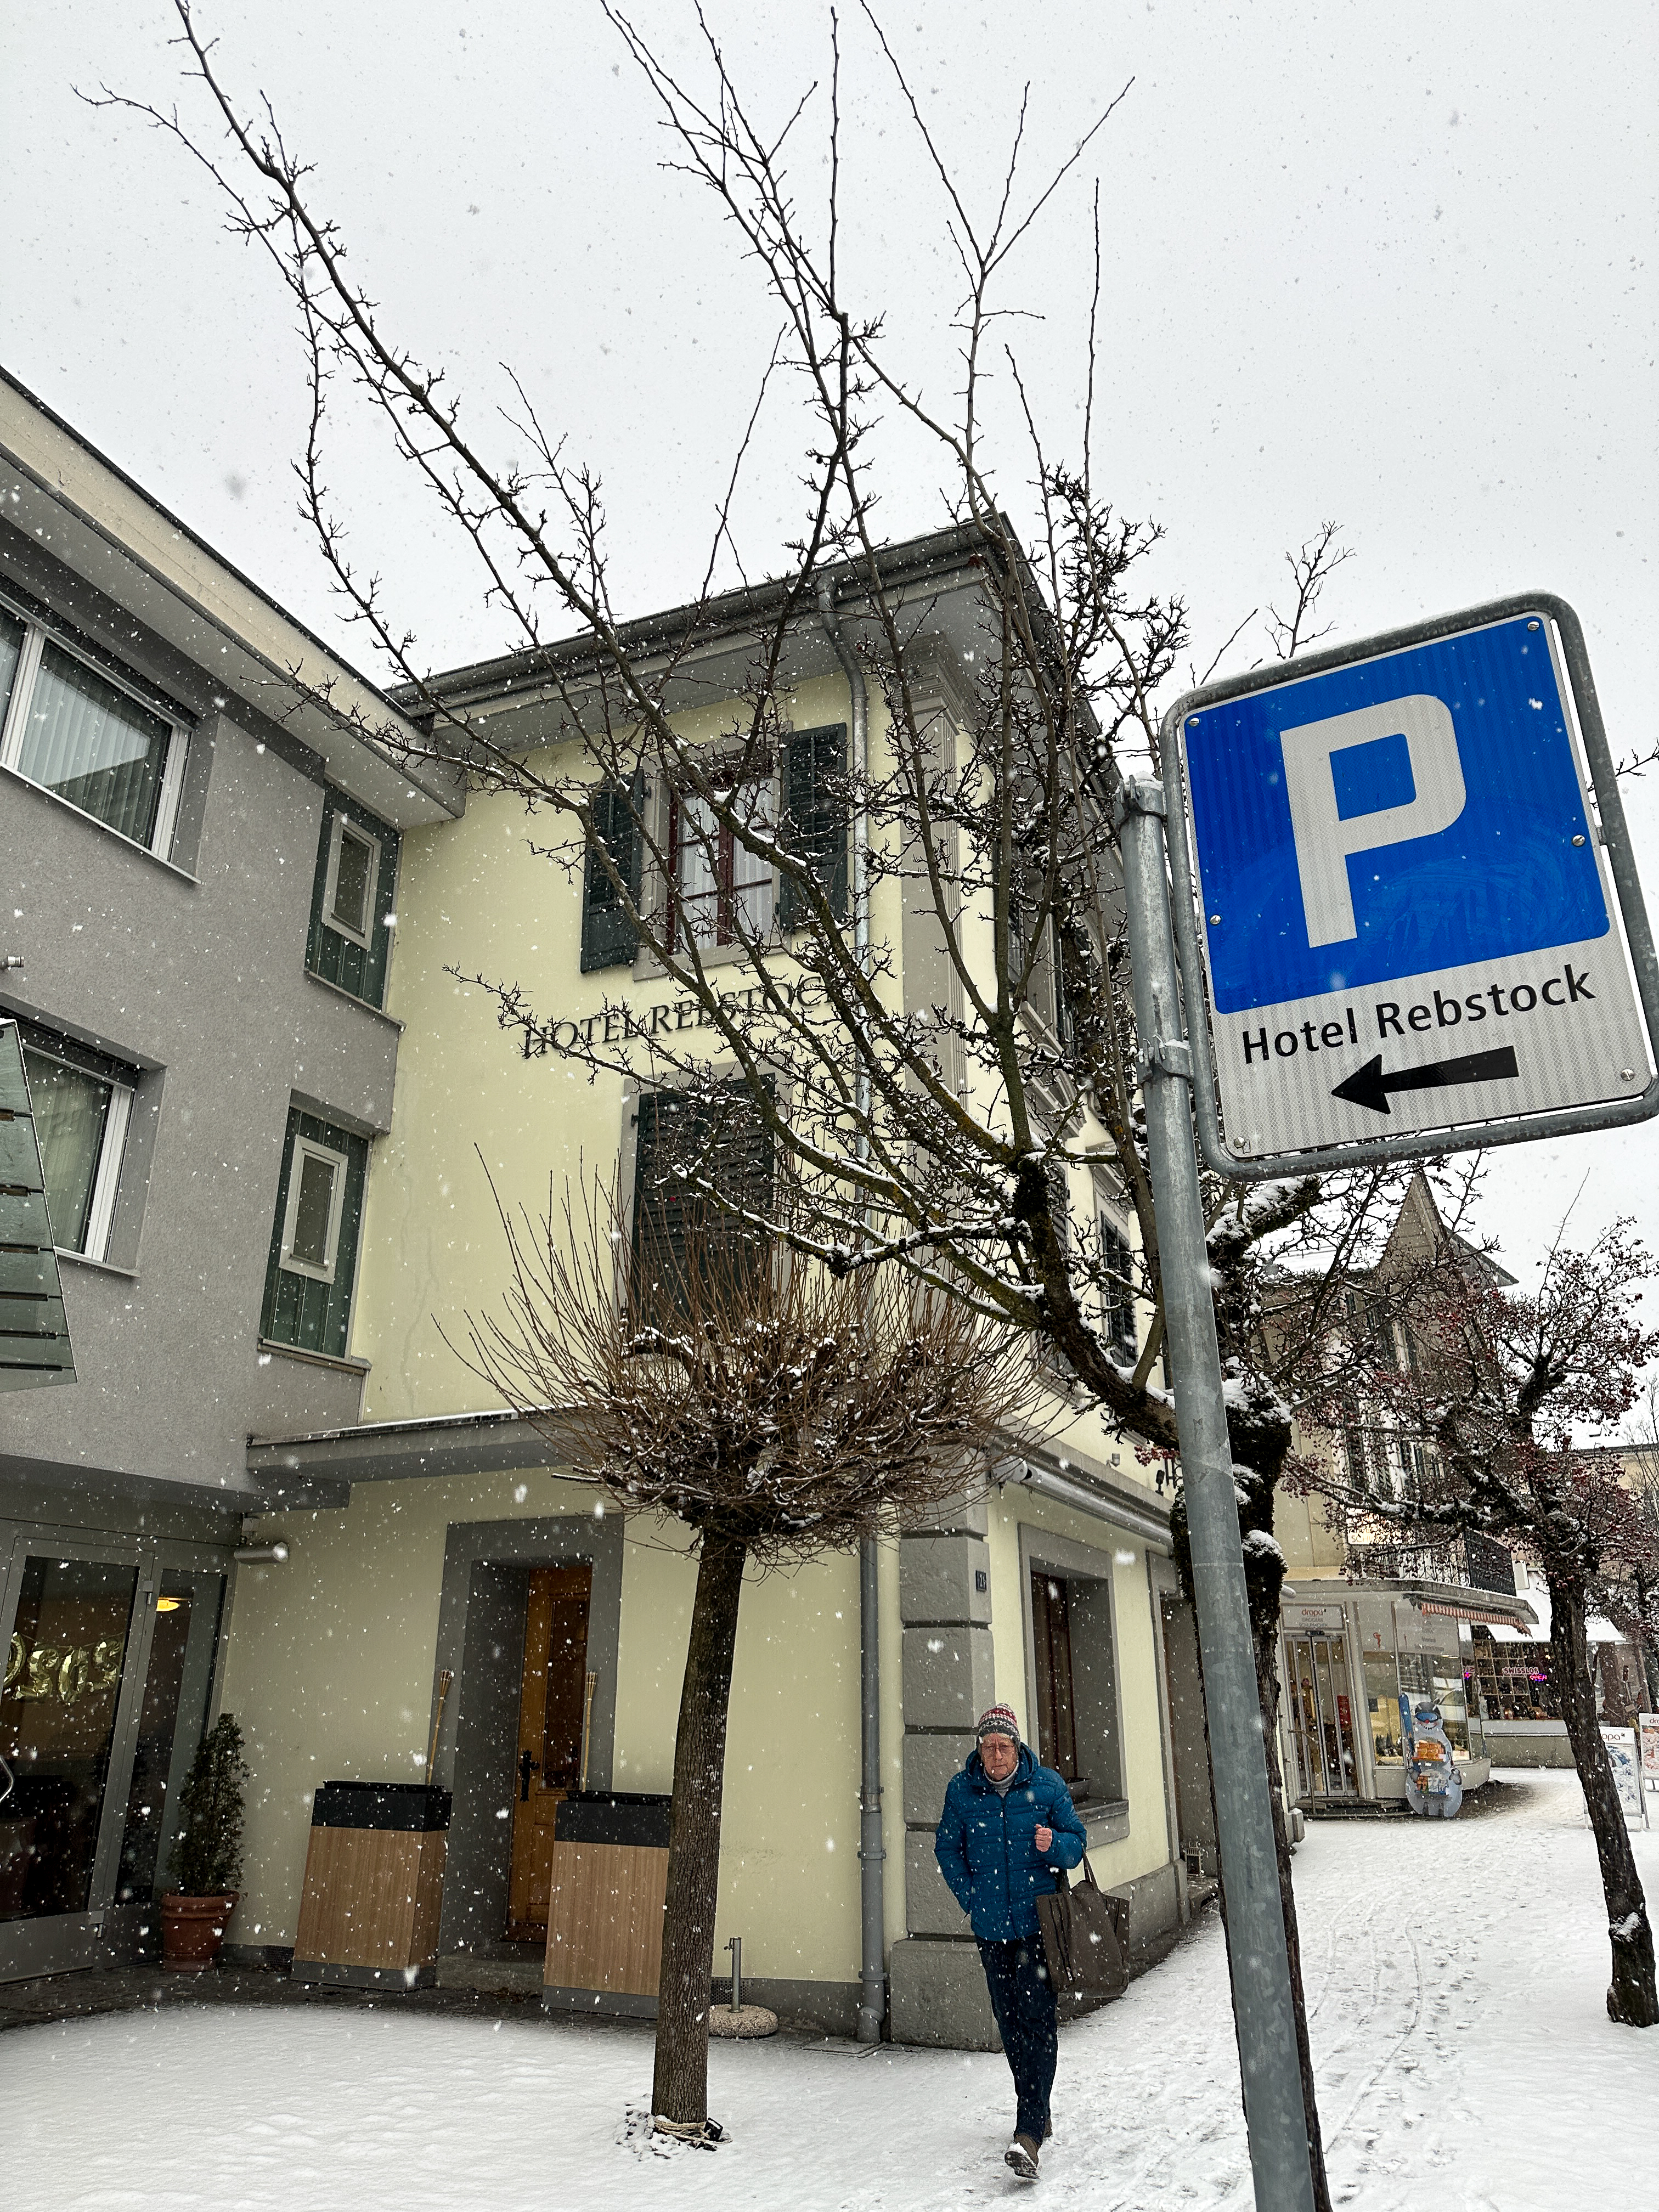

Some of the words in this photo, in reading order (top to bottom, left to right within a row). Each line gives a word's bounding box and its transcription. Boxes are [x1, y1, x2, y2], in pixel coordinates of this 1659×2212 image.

[1280, 694, 1466, 947] P
[522, 1009, 639, 1058] HOTEL
[650, 976, 836, 1034] REBSTOC
[1242, 1007, 1358, 1064] Hotel
[1375, 964, 1596, 1039] Rebstock
[1301, 1608, 1324, 1617] dropa
[1502, 1667, 1539, 1675] SWISSLOS
[1602, 1734, 1621, 1742] opa
